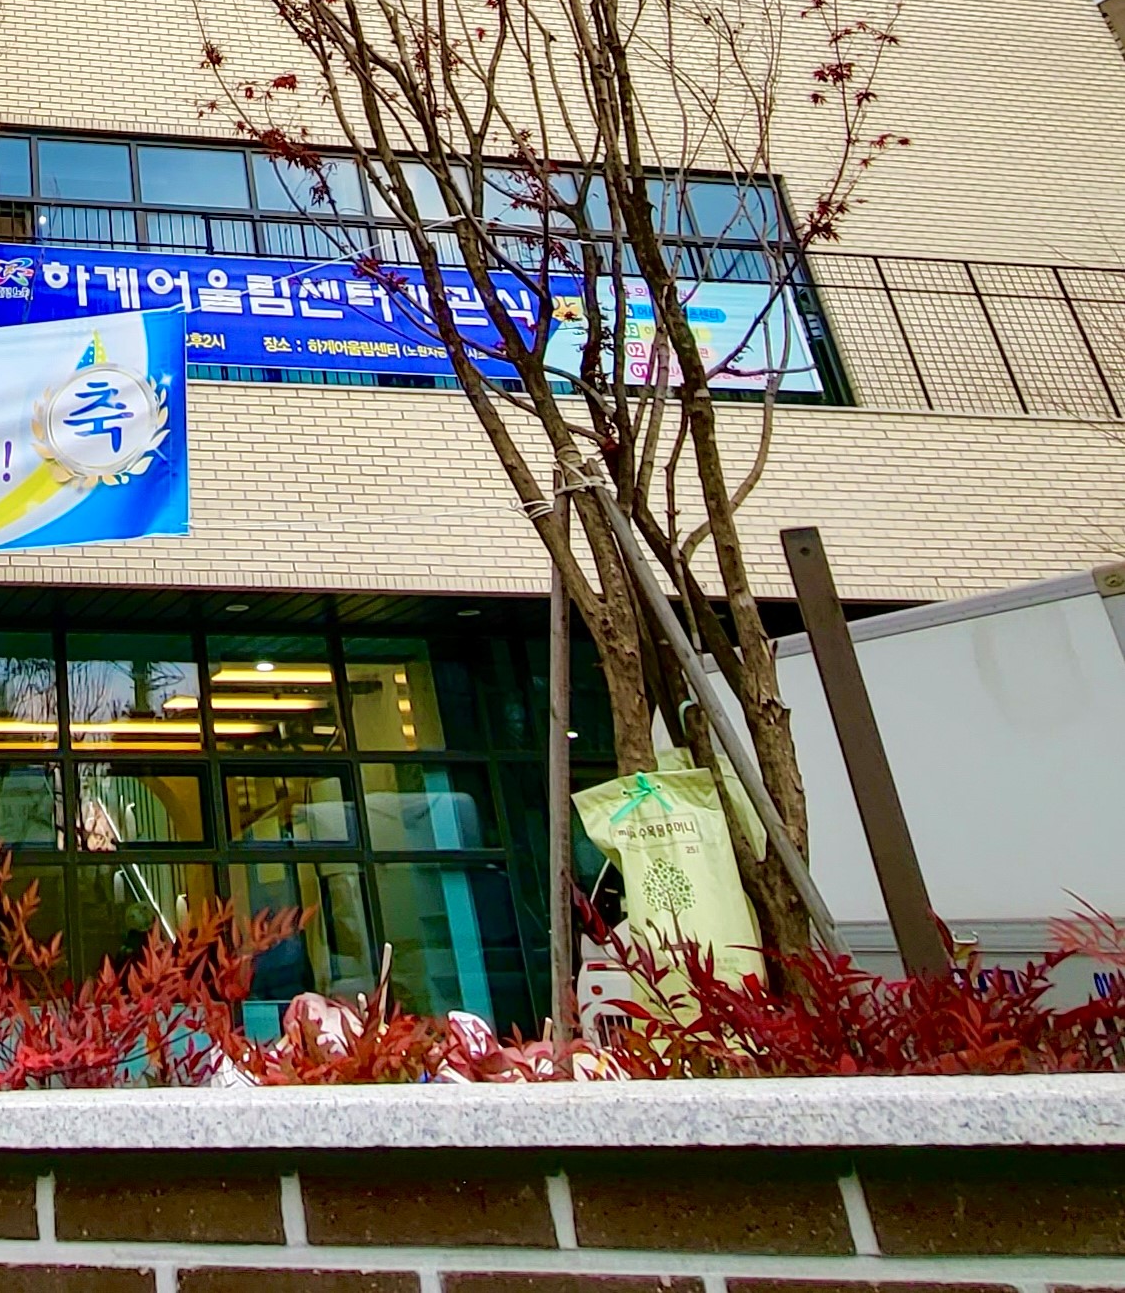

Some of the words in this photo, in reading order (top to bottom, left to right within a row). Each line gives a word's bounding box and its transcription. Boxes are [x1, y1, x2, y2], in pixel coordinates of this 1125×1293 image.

[42, 261, 394, 324] 하계어울림센터
[263, 336, 293, 353] 장소
[626, 344, 645, 357] 02
[62, 378, 135, 454] 축
